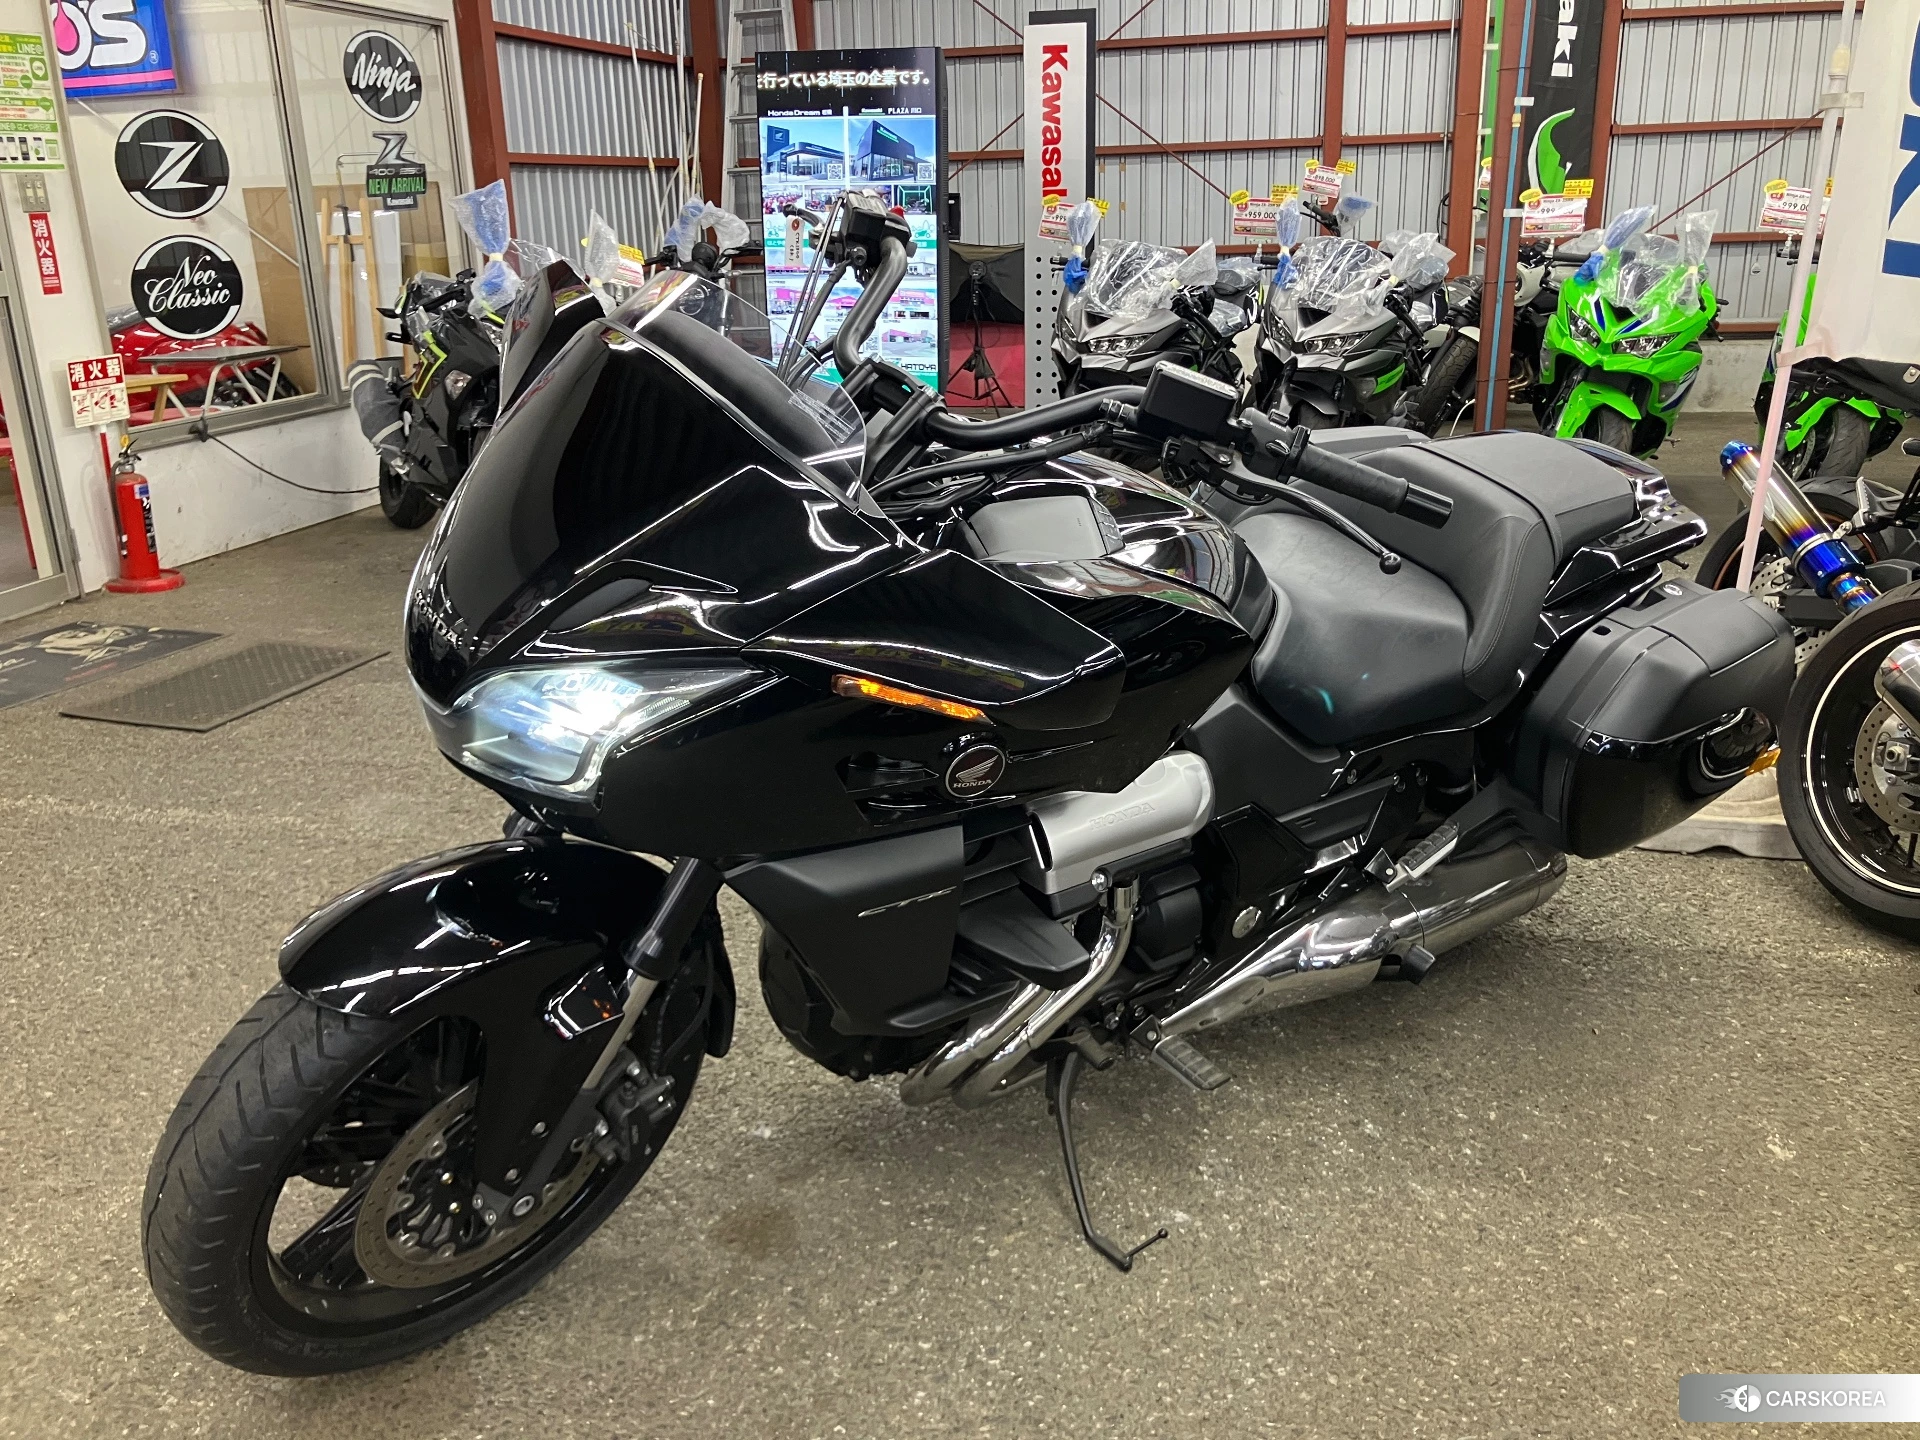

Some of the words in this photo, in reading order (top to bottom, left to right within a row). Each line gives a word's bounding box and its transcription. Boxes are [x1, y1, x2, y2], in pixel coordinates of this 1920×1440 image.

[351, 51, 417, 101] Ninja
[888, 107, 909, 115] PLAZA
[139, 141, 209, 190] Z
[368, 168, 396, 176] 400
[399, 167, 425, 176] 250
[368, 178, 389, 195] NEW
[391, 176, 426, 194] ARRIVAL
[32, 219, 56, 275] 消火器
[172, 255, 218, 288] Neo
[143, 279, 231, 313] Classic
[70, 358, 121, 382] 消火器
[901, 363, 937, 371] HATOYA
[953, 779, 992, 788] HONDA
[1088, 802, 1156, 831] HONDA
